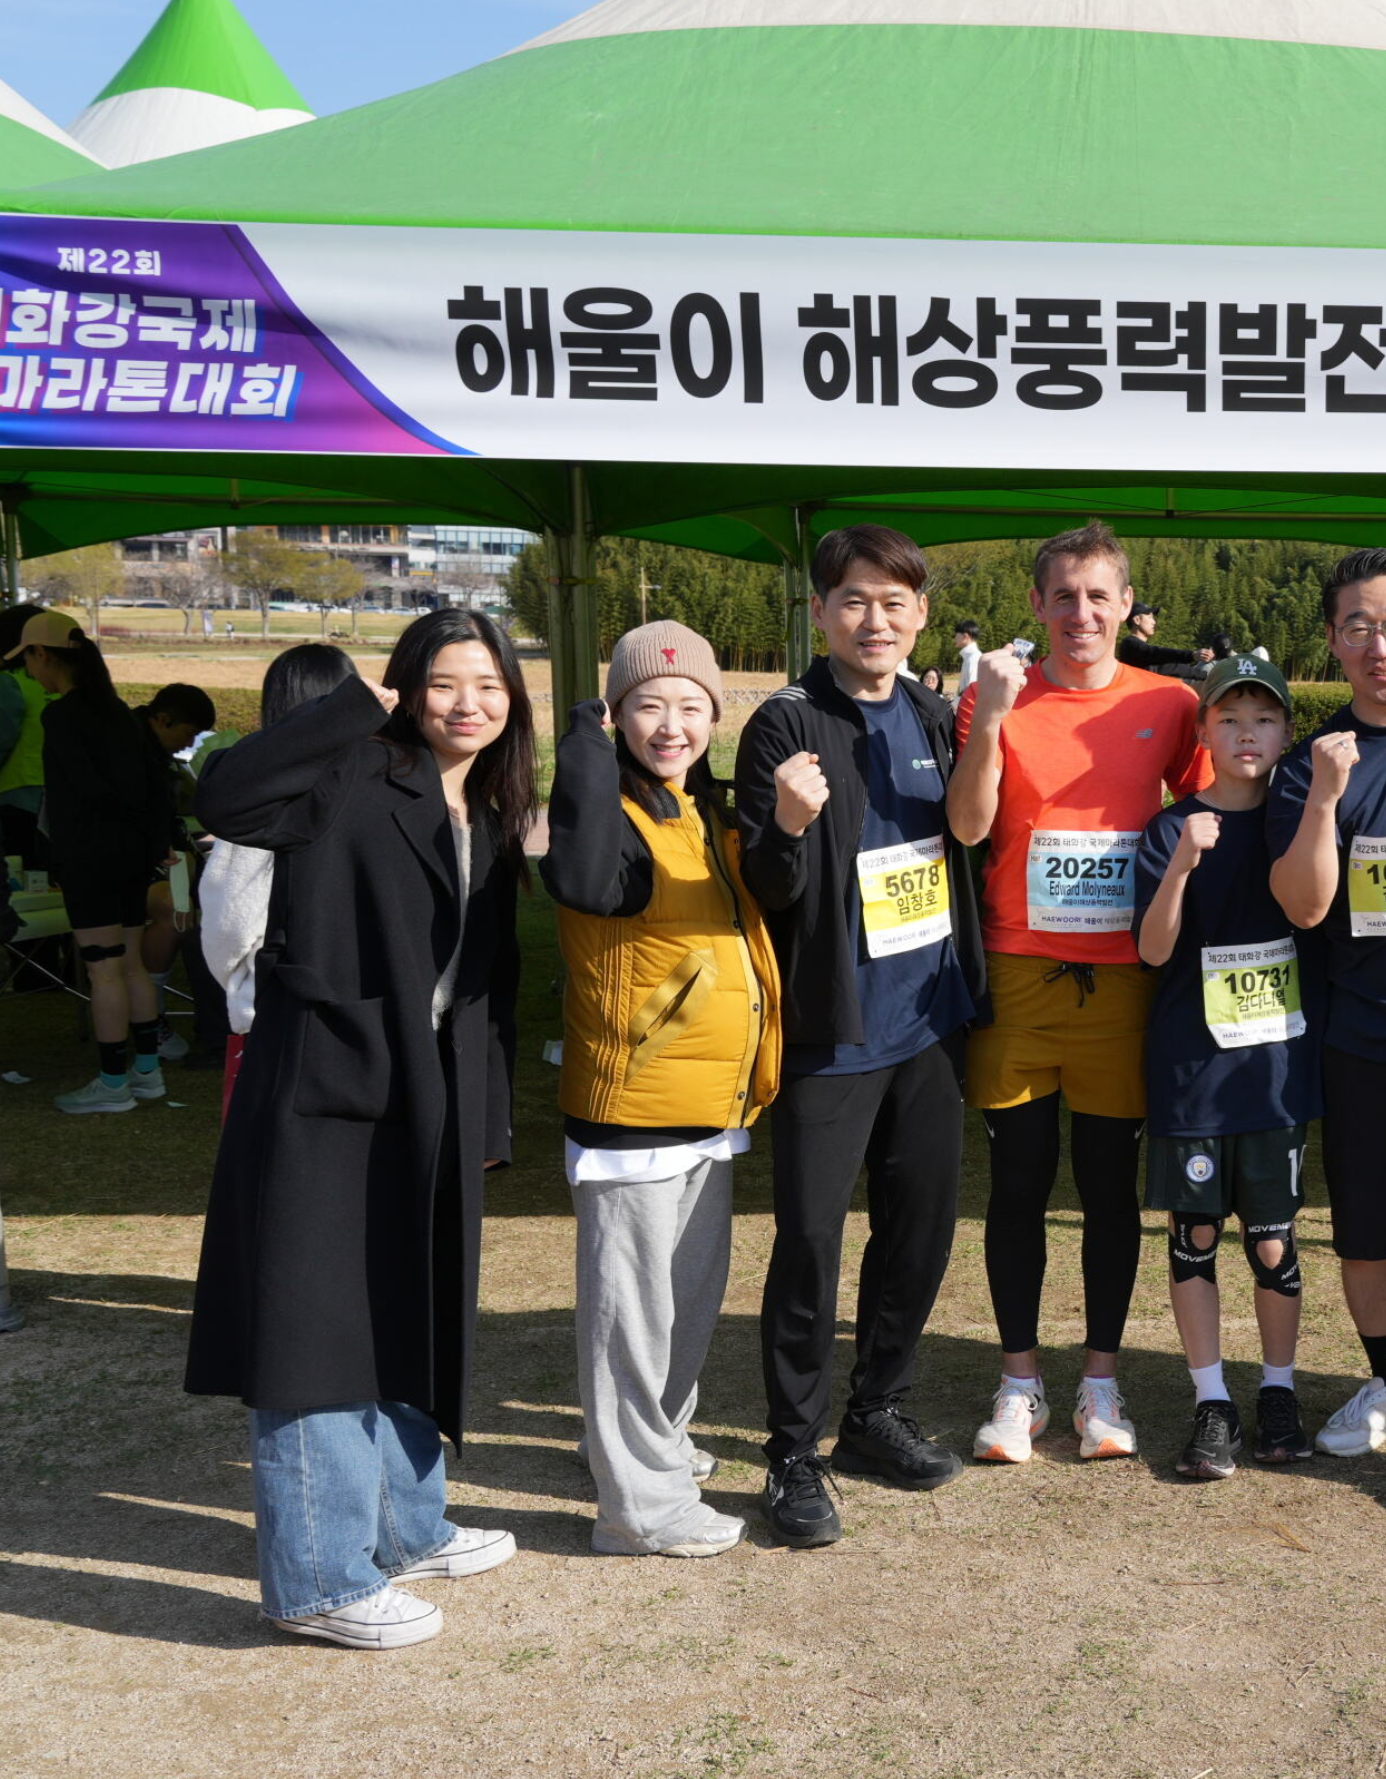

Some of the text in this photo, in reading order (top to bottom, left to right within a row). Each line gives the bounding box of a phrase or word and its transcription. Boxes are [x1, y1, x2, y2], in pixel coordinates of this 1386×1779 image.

[57, 247, 161, 276] 제22회
[0, 287, 257, 353] 화강국제
[447, 285, 764, 404] 해울이
[1237, 658, 1258, 676] LA
[1034, 835, 1060, 846] 제22회
[1063, 836, 1086, 847] 태화강
[1355, 844, 1378, 854] 제22회
[1045, 857, 1130, 879] 20257
[885, 864, 940, 898] 5678
[1049, 881, 1125, 898] Edward Molyneaux
[897, 889, 938, 916] 임창호
[1208, 952, 1237, 964] 제22회
[1238, 950, 1261, 962] 태화강
[1224, 965, 1290, 995] 10731
[1236, 988, 1286, 1013] 김다니엘
